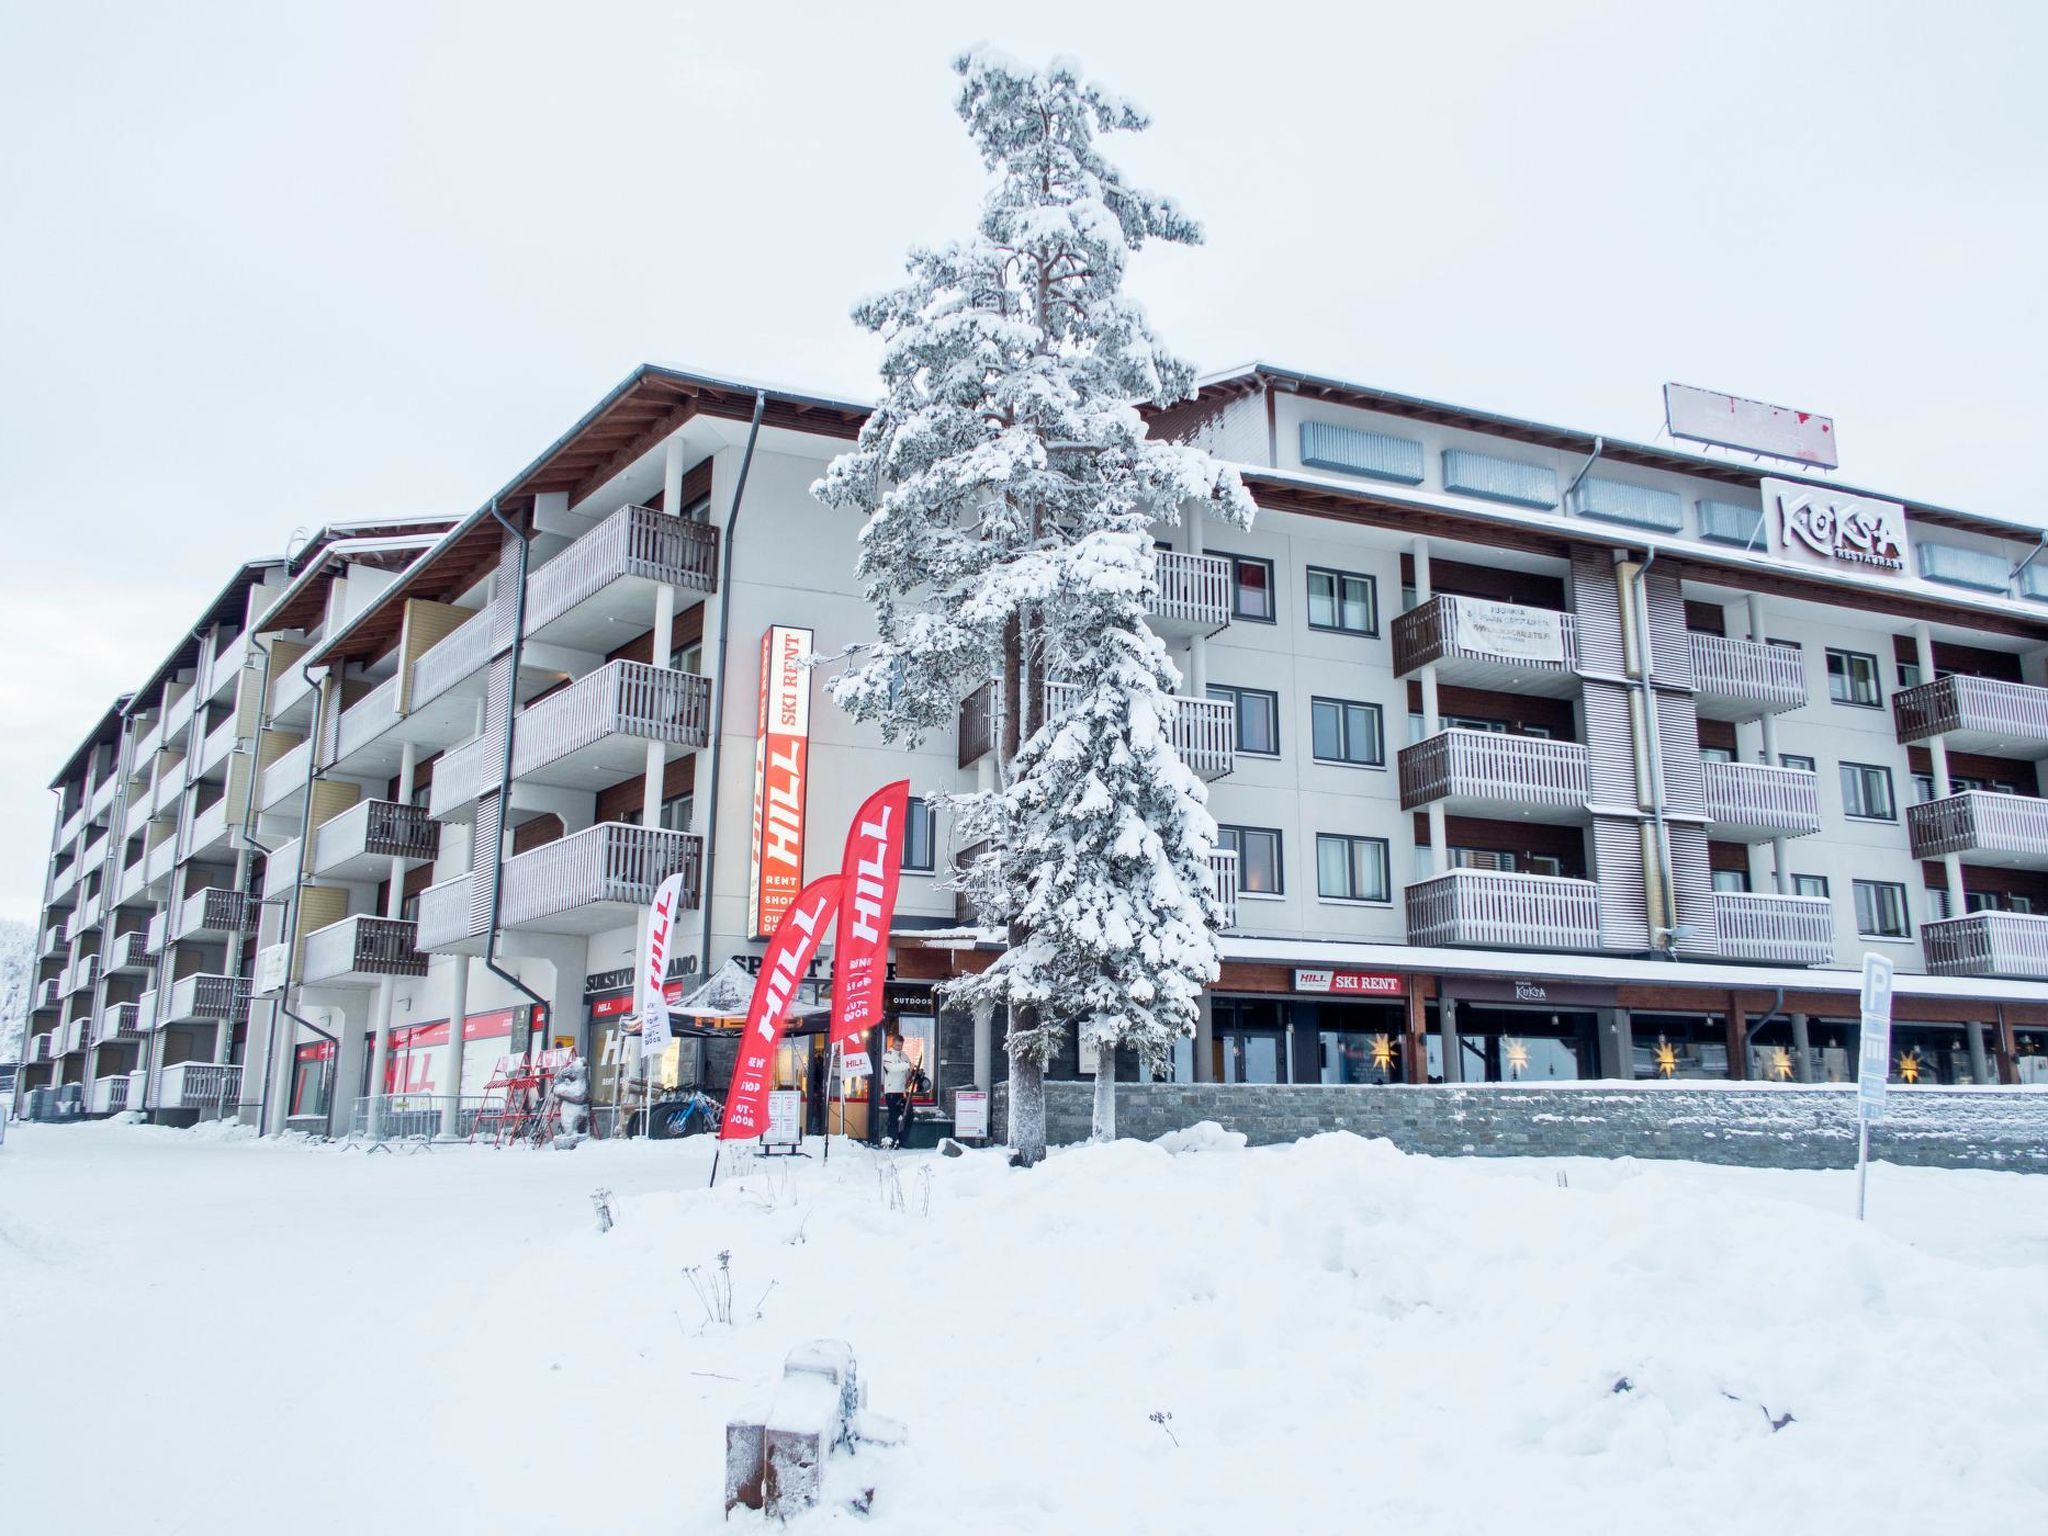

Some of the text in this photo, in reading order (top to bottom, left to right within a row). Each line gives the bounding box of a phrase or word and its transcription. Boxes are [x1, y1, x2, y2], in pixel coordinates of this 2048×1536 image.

[782, 634, 800, 727] SKI RENT
[767, 740, 800, 868] HILL
[766, 875, 797, 886] RENT
[852, 805, 893, 944] HILL
[650, 891, 671, 992] HILL
[586, 955, 697, 992] SUKSIVUAMO
[757, 895, 828, 1043] HILL
[1300, 973, 1397, 990] HILL SKI RENT
[1869, 964, 1888, 1011] P
[893, 997, 932, 1005] OUTDOOR
[1516, 986, 1546, 1000] KUKSA
[845, 1058, 865, 1068] HILL
